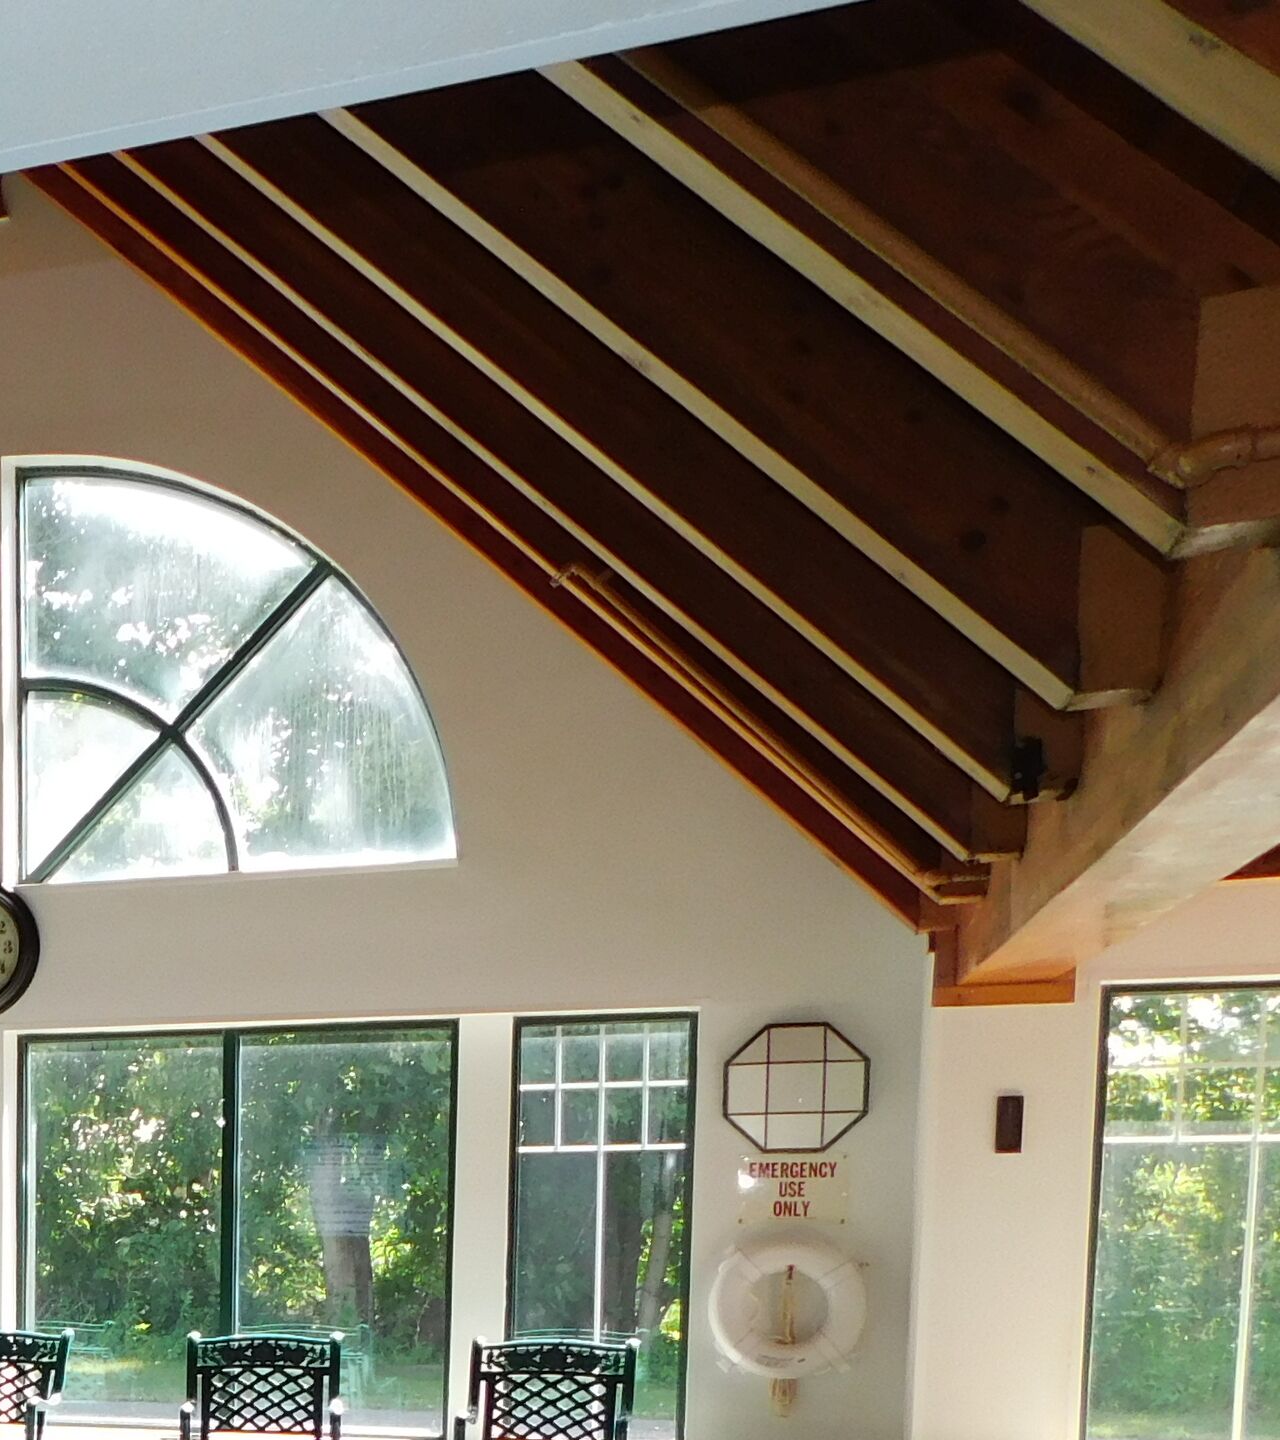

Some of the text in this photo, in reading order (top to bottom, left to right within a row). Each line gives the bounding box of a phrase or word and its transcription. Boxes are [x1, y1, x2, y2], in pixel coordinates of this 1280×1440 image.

[3, 940, 13, 954] 3
[749, 1162, 838, 1179] EMERGENCY
[778, 1181, 805, 1198] USE
[773, 1201, 811, 1217] ONLY
